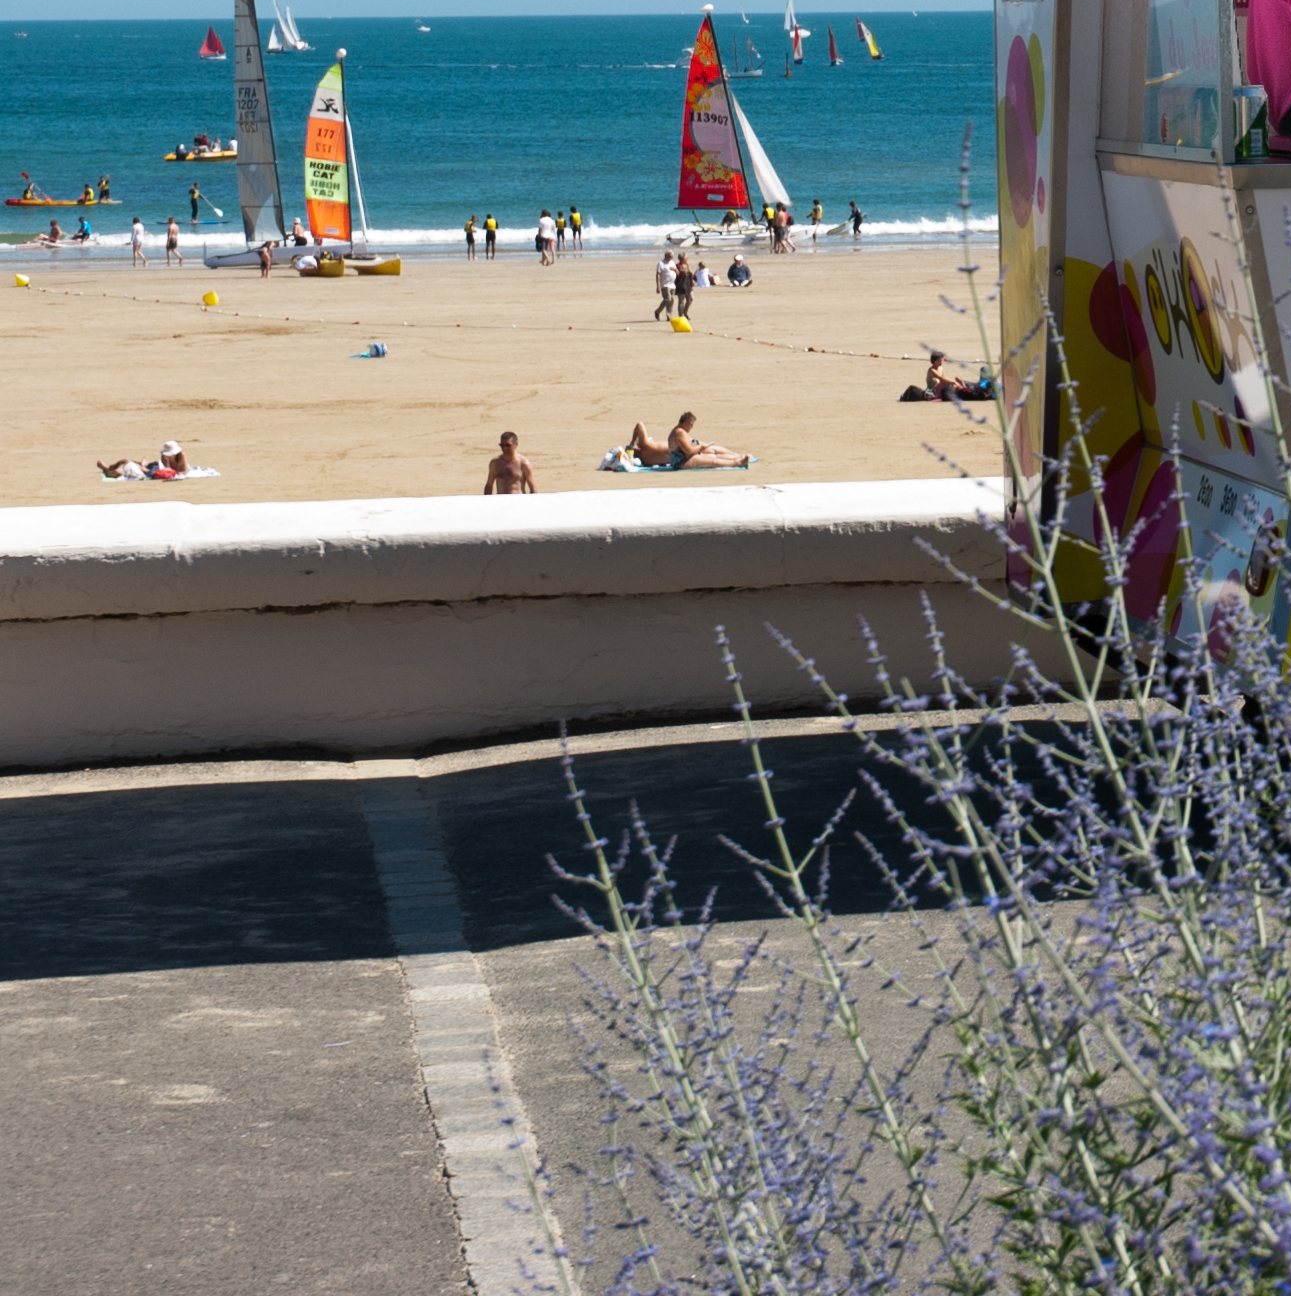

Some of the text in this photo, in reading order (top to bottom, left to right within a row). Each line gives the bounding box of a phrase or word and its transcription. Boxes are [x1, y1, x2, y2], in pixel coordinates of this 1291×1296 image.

[238, 87, 257, 98] FRA
[690, 111, 729, 126] 113907
[317, 128, 335, 139] 177
[309, 161, 341, 173] HOBIE
[313, 170, 335, 180] CAT
